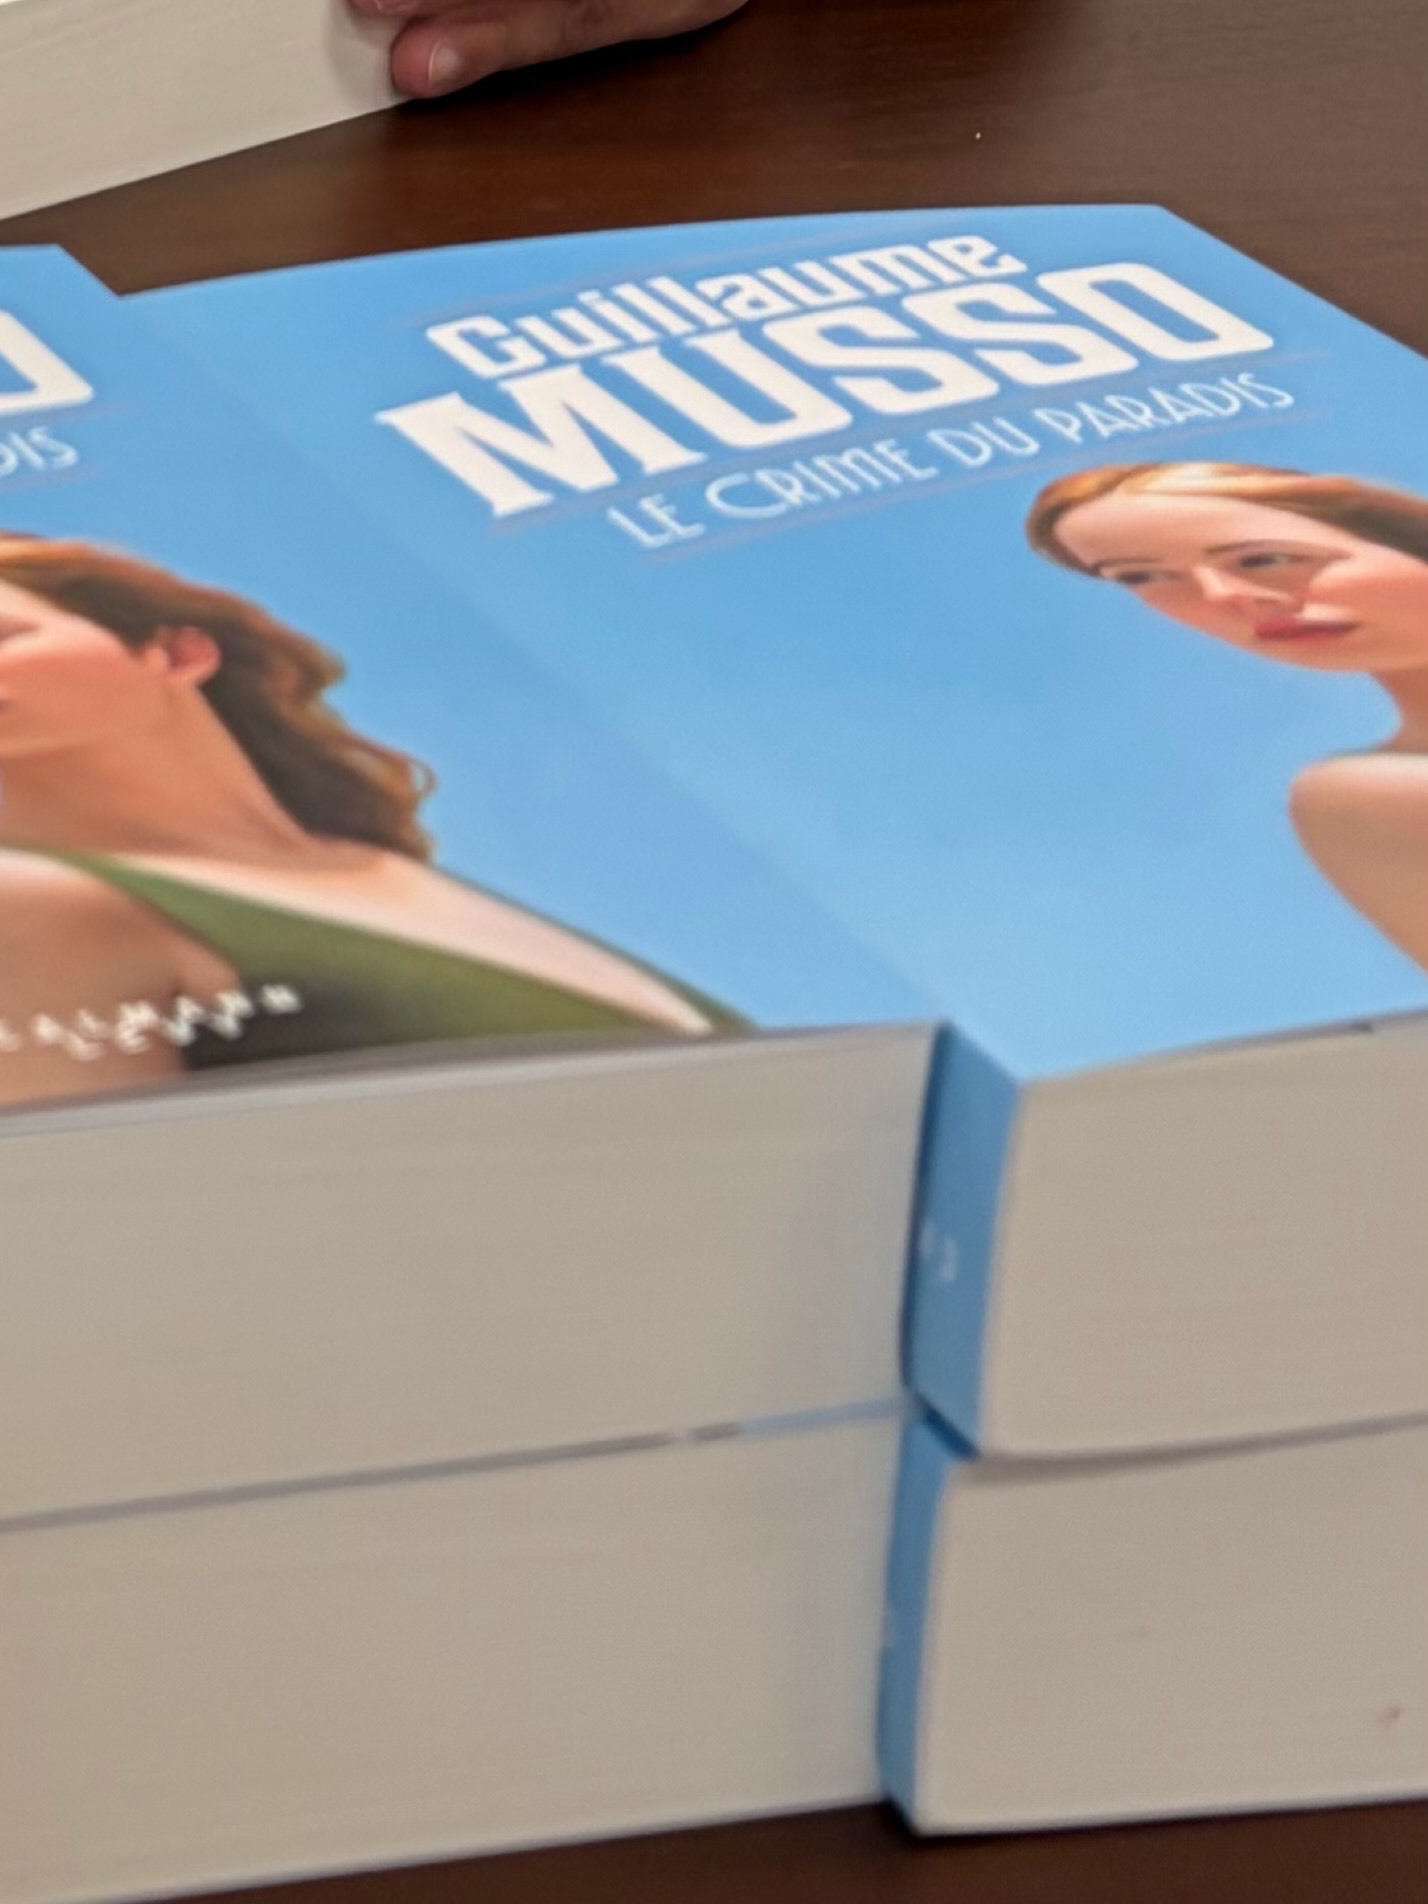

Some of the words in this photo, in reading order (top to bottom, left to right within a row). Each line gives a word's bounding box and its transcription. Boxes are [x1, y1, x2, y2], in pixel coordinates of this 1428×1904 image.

[374, 261, 1276, 518] MUSSO
[425, 233, 1028, 380] Guillaume
[606, 493, 705, 550] LE
[704, 438, 938, 519] CRIME
[928, 415, 1041, 468] DU
[1033, 371, 1296, 445] PARADIS
